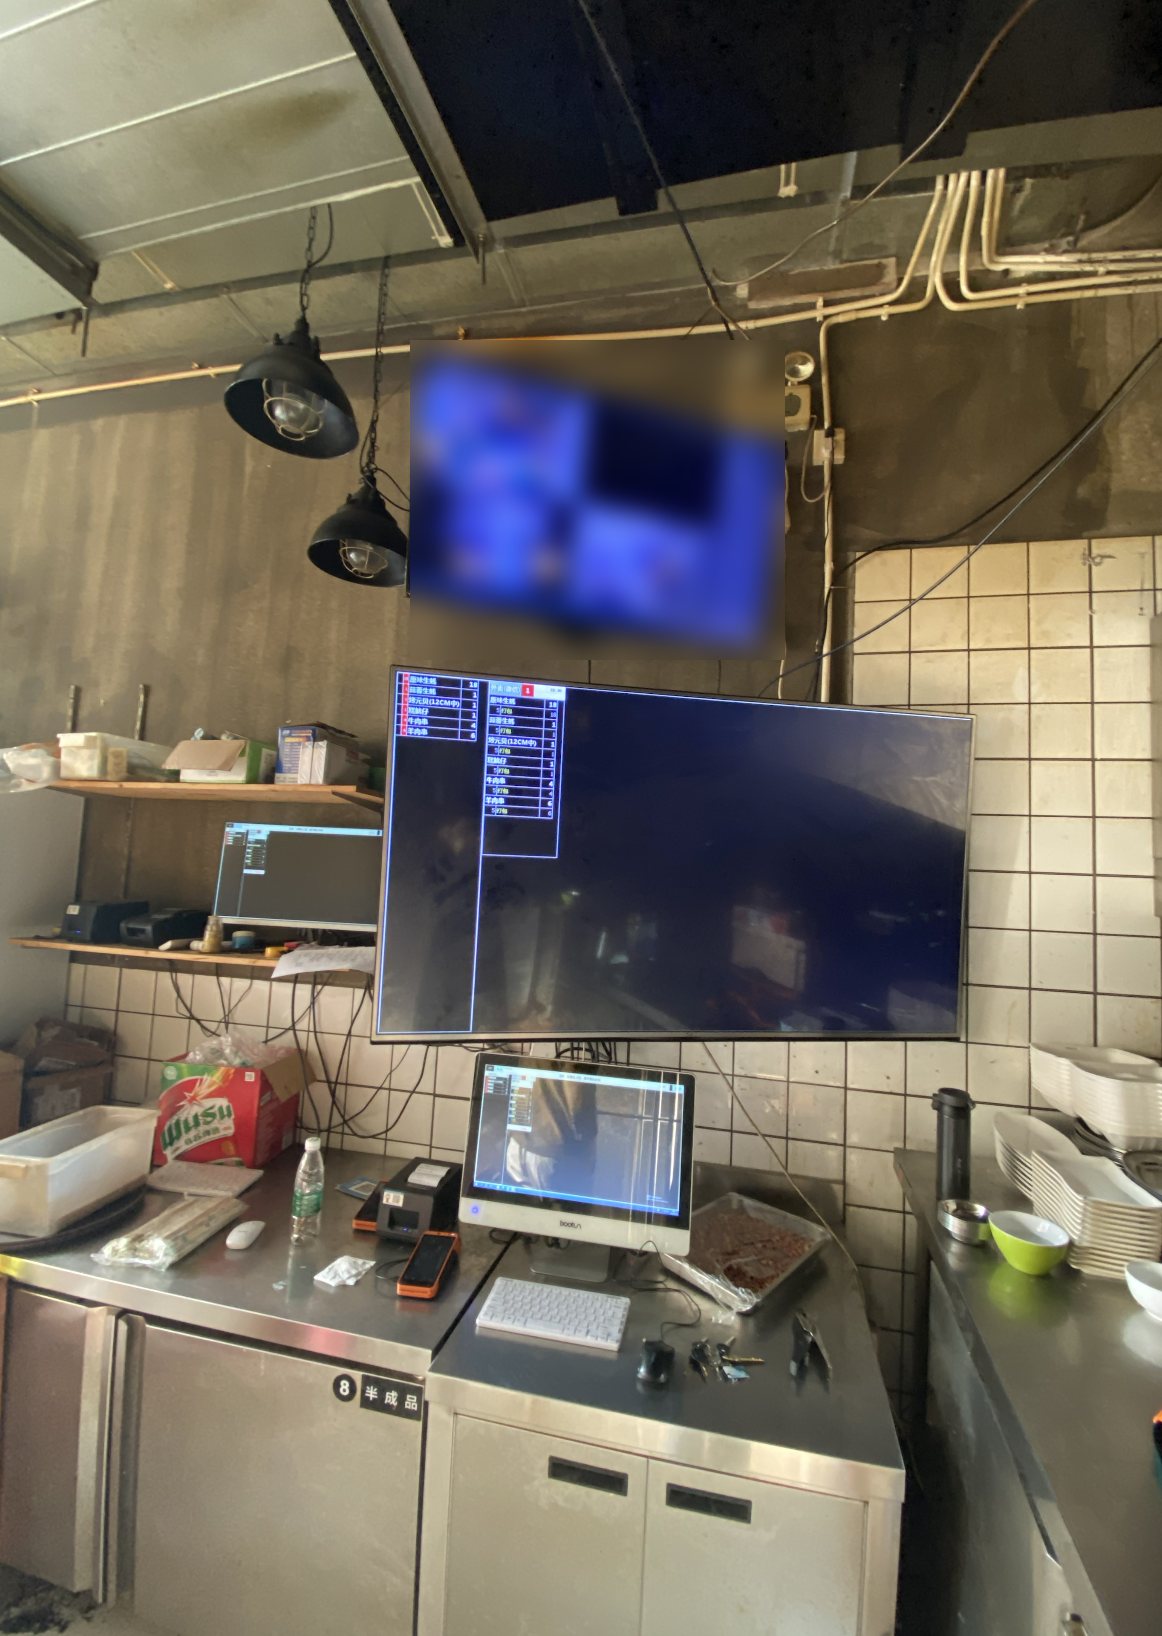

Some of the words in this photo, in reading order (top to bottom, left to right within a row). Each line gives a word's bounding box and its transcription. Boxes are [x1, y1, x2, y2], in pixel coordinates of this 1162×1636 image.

[339, 1379, 350, 1396] 8
[364, 1385, 418, 1411] 半成品
